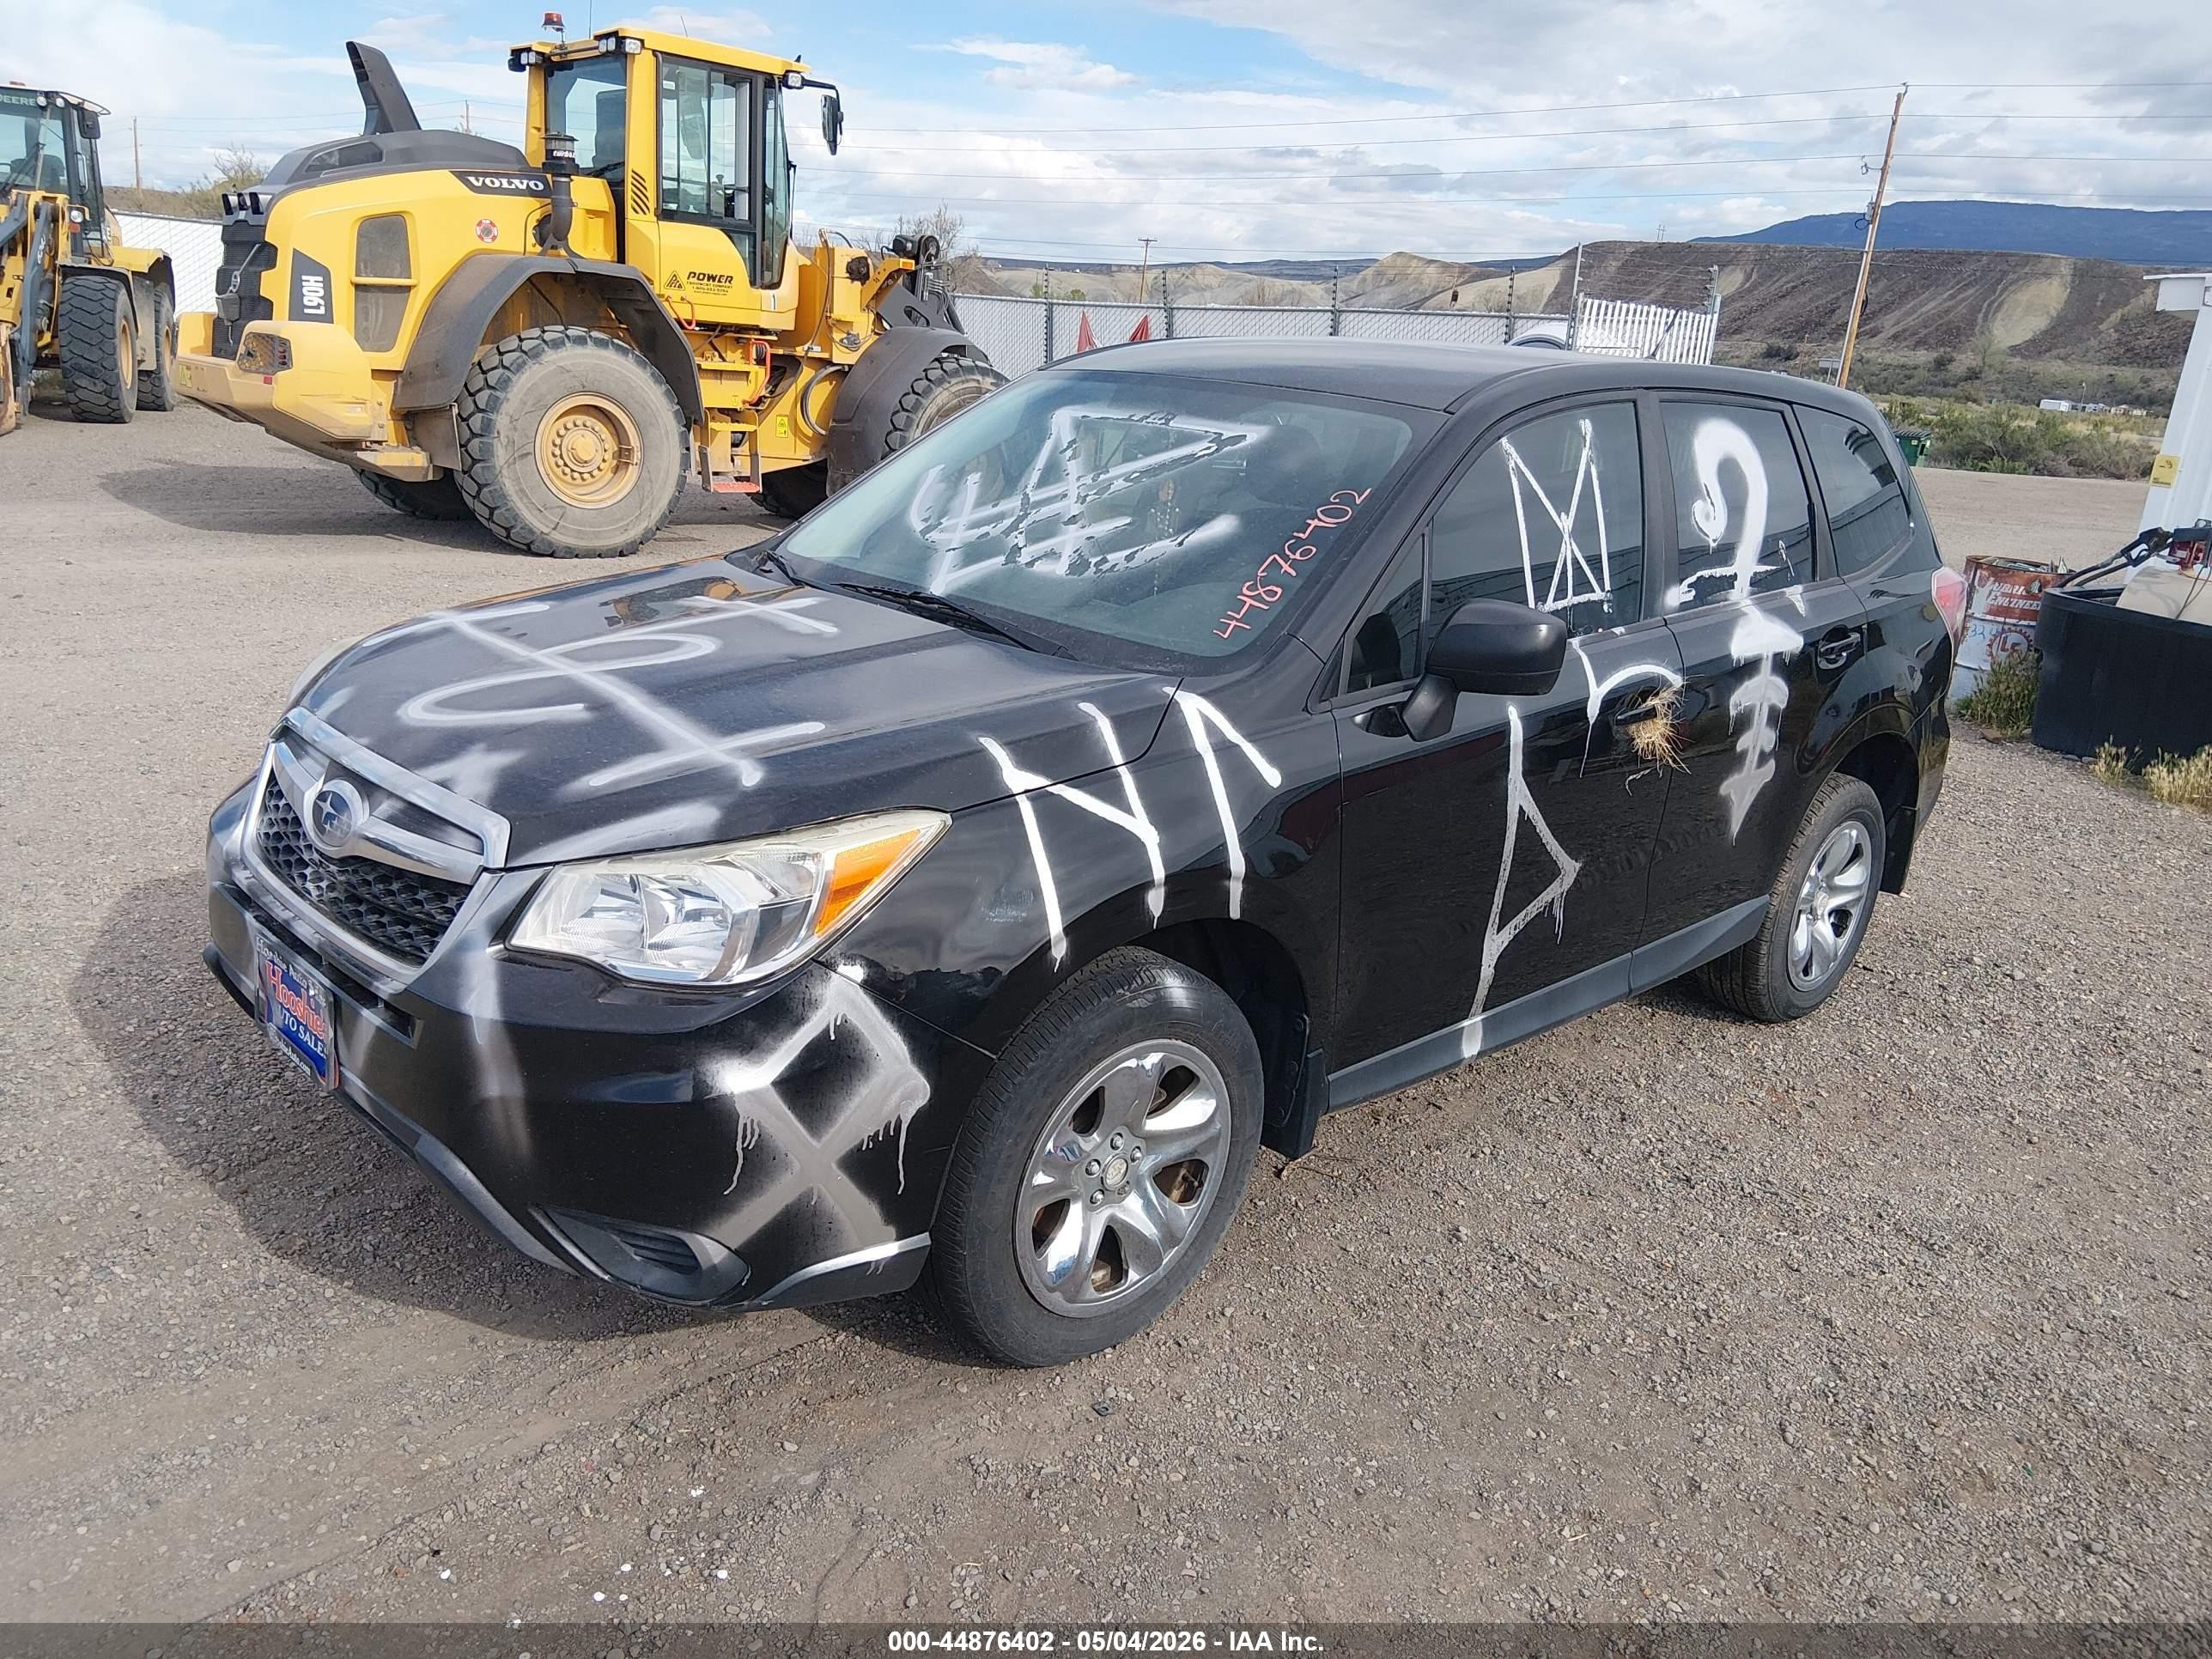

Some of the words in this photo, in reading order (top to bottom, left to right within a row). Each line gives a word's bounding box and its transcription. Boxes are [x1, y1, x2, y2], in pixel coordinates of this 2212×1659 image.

[467, 176, 544, 191] VOLVO
[687, 271, 733, 284] POWER
[301, 275, 325, 314] L90H
[1212, 487, 1372, 639] 44876402
